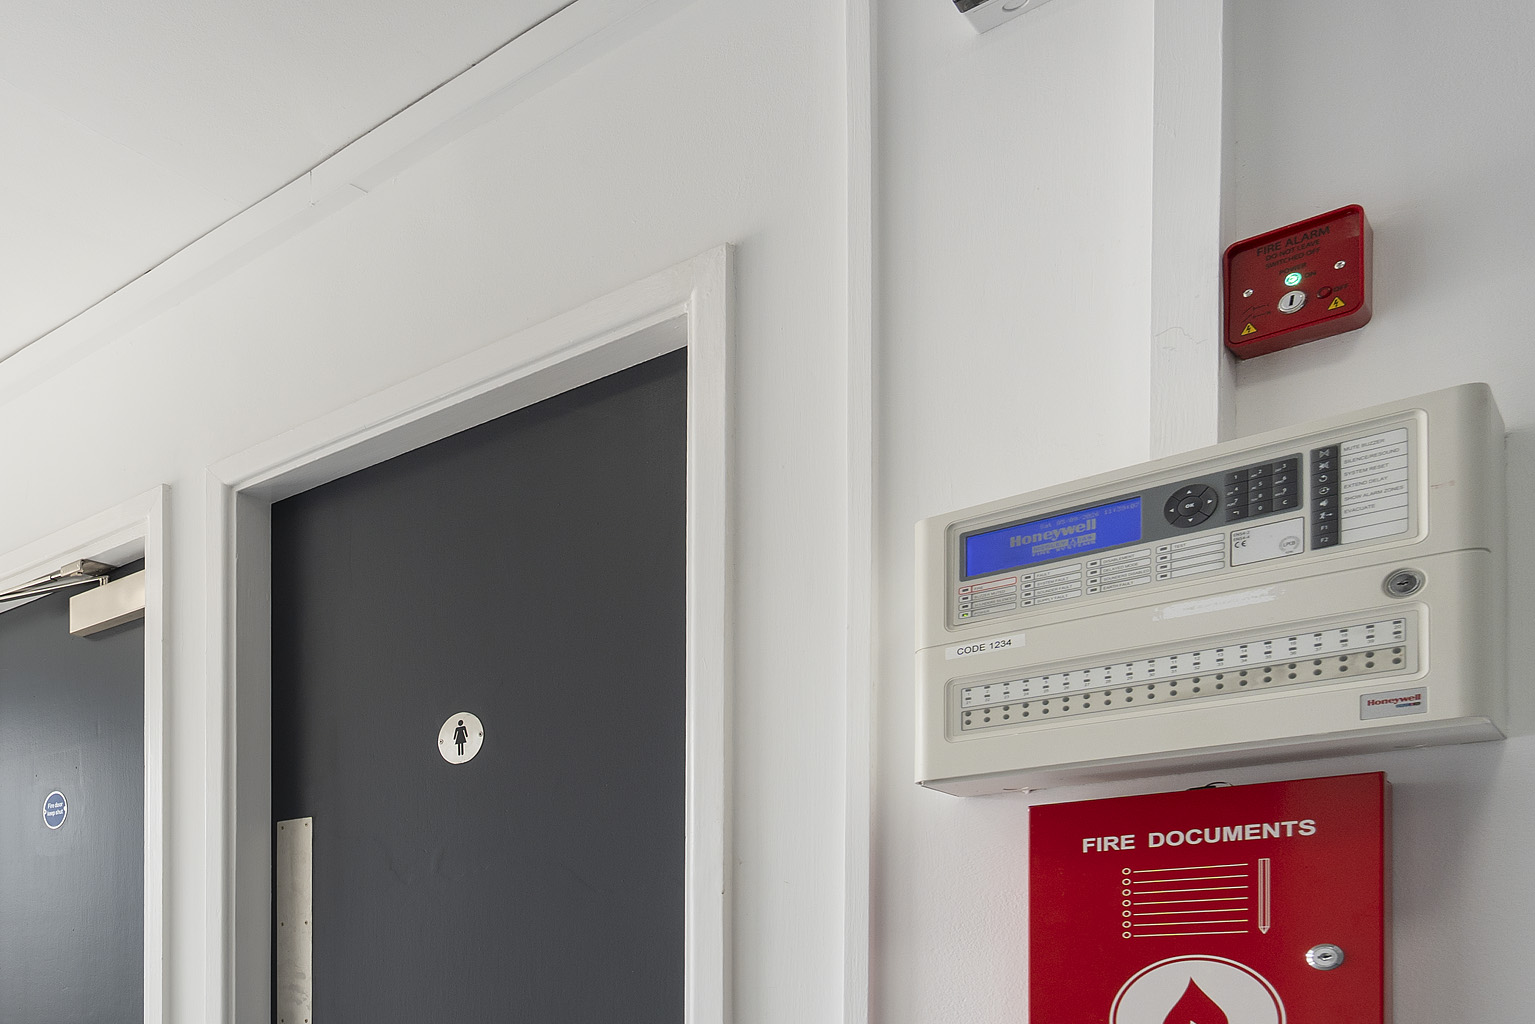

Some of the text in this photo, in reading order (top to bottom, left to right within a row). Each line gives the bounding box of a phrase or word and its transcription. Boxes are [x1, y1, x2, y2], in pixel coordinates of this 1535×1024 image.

[1256, 225, 1330, 256] FIRE ALARM
[1279, 248, 1296, 258] NOT
[1296, 239, 1320, 252] LEAVE
[1265, 247, 1321, 269] SWITCHED OFF
[1278, 262, 1307, 275] POWER
[1305, 270, 1317, 279] ON
[1344, 443, 1360, 451] MUTE
[1344, 463, 1389, 477] SYSTEM RESET
[1344, 475, 1389, 489] EXTEND DELAY
[1362, 490, 1383, 498] ALARM
[1383, 485, 1404, 493] ZONES
[1344, 503, 1375, 514] EVACUATE
[1009, 518, 1096, 548] Honeywell
[956, 638, 1012, 656] CODE 1234
[1367, 694, 1421, 706] Honeywell
[1082, 819, 1317, 853] FIRE DOCUMENTS
